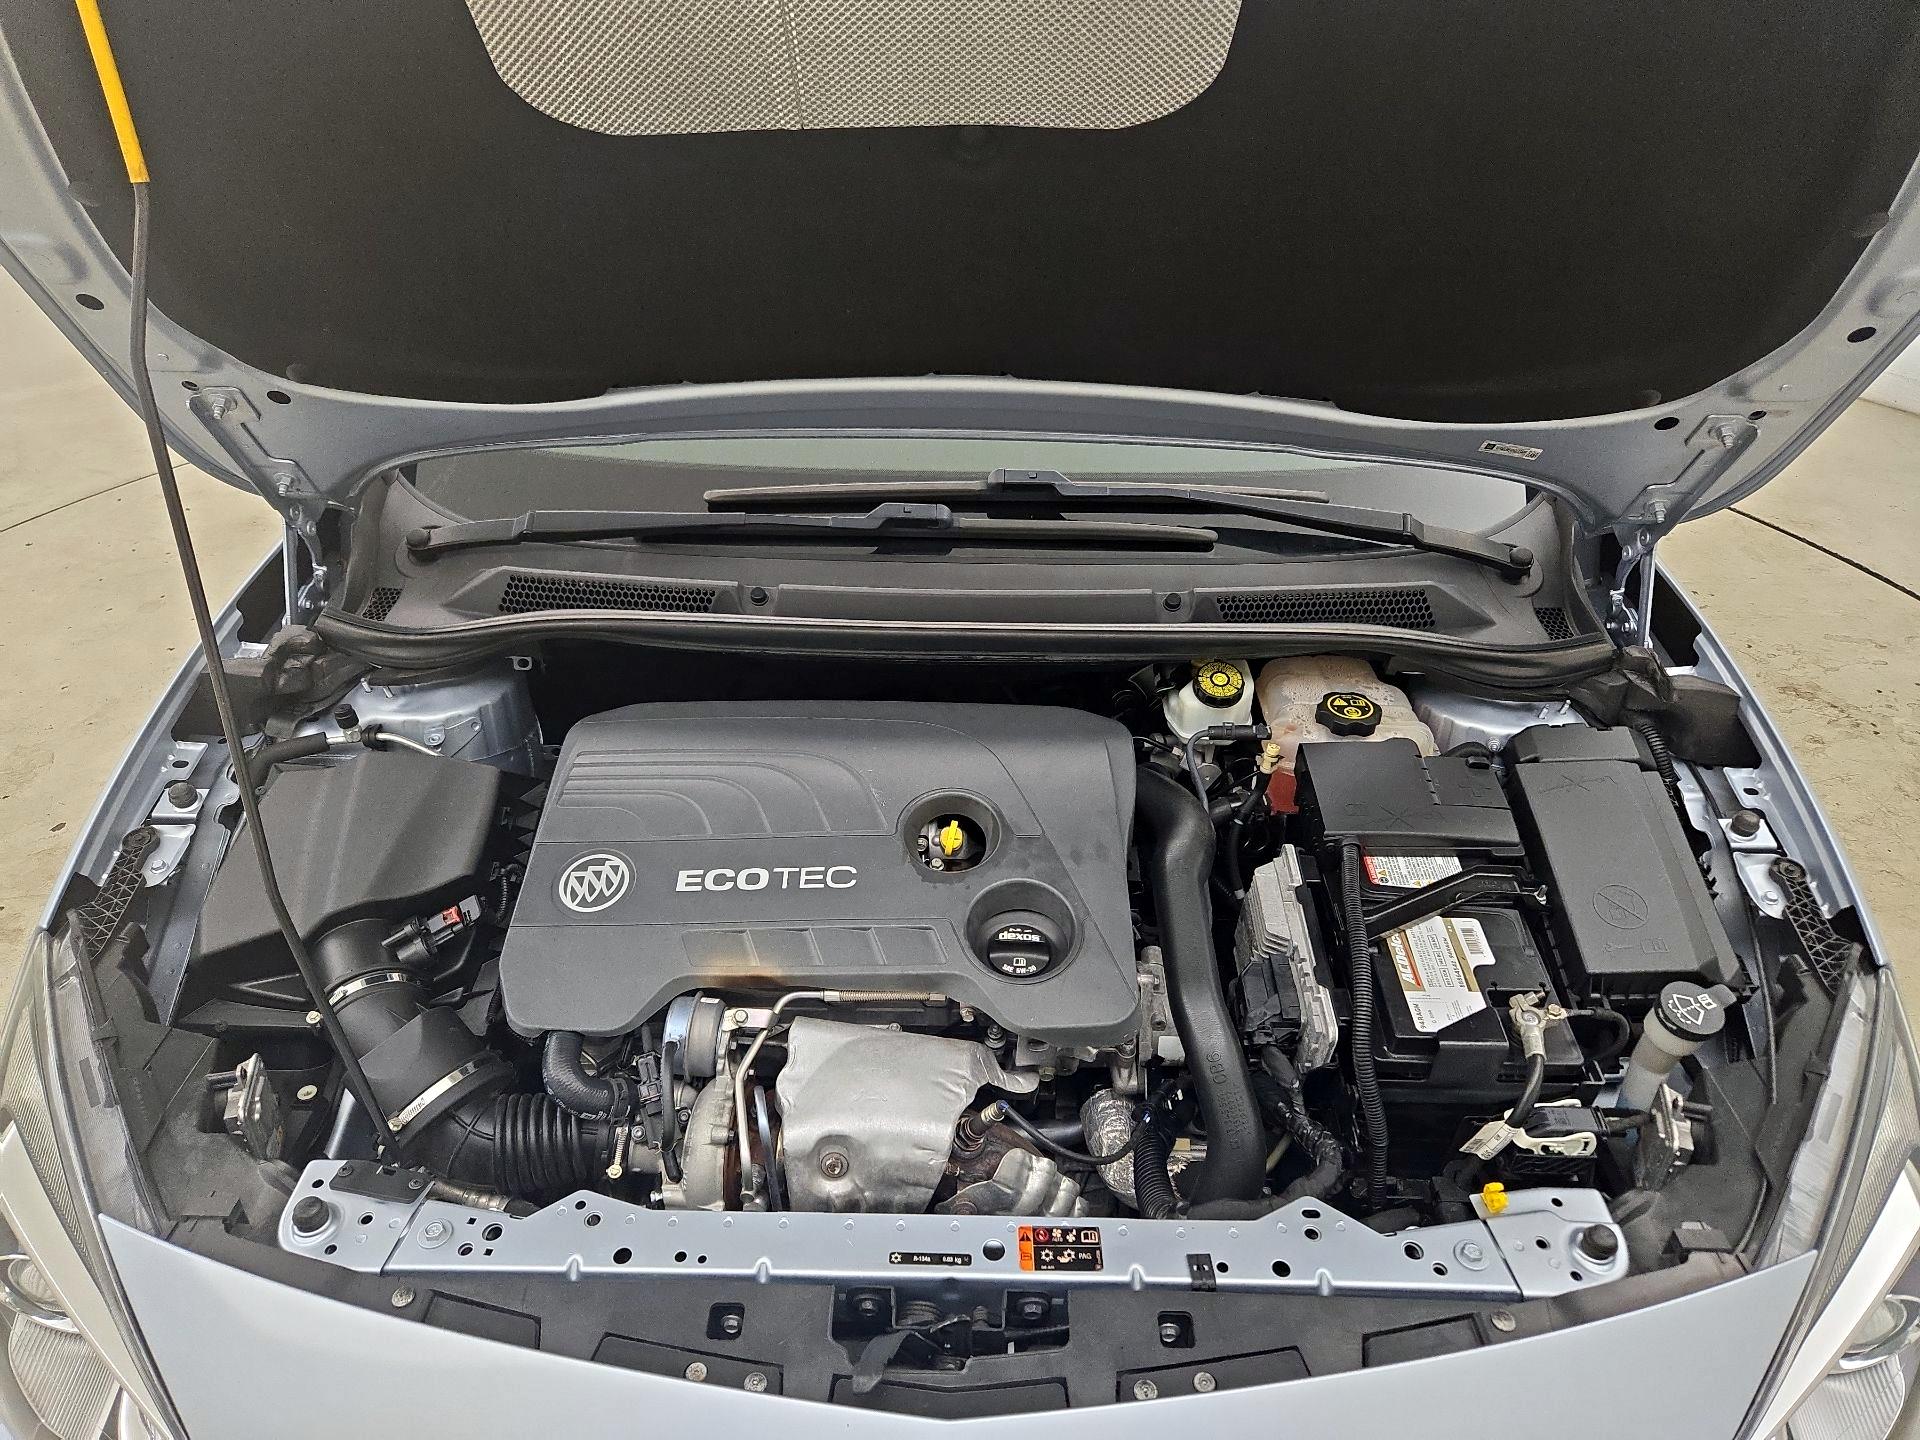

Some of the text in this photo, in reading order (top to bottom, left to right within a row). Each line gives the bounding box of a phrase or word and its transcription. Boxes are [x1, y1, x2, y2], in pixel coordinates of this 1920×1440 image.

[676, 866, 857, 892] ECOTEC
[998, 931, 1041, 941] dexos
[1391, 932, 1416, 985] ACDelc
[1002, 964, 1014, 973] SAE
[1413, 1003, 1427, 1029] 94RAGM
[955, 1256, 962, 1265] kg
[1078, 1252, 1092, 1260] PAG
